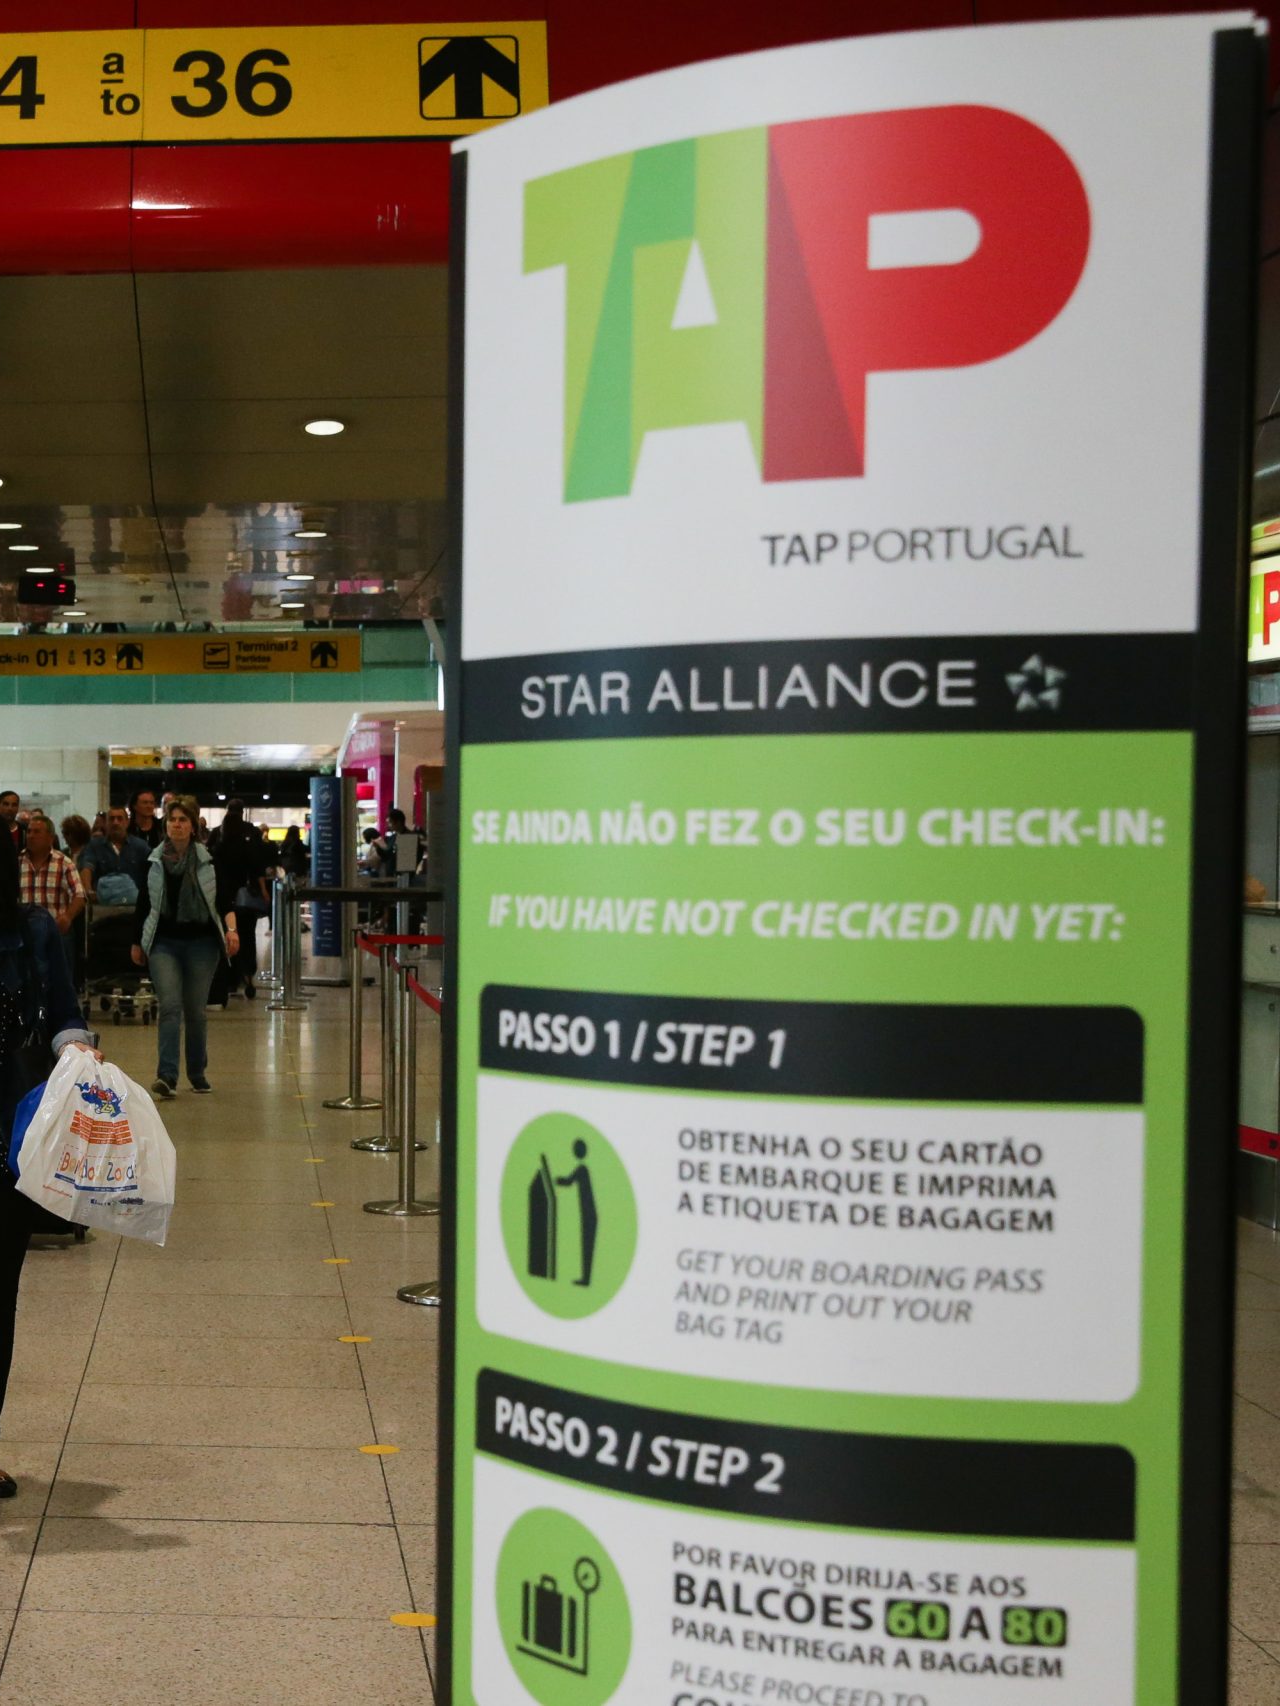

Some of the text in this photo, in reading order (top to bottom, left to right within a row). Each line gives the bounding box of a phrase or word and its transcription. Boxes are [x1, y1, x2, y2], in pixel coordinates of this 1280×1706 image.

[101, 52, 125, 75] a
[171, 48, 293, 117] 36
[101, 87, 141, 115] to
[523, 103, 1092, 505] TAP
[761, 524, 1084, 567] TAP PORTUGAL
[36, 648, 59, 668] 01
[82, 647, 106, 667] 13
[236, 640, 299, 653] Terminal 2
[521, 660, 976, 719] STAR ALLIANCE
[471, 802, 1167, 847] SE AINDA NÃO FEZ O SEU CHECK-IN:
[488, 894, 1126, 941] IF YOU HAVE NOT CHECKED IN YET:
[498, 1009, 787, 1069] PASSO 1 / STEP 1
[678, 1128, 1042, 1166] OBTENHA O SEU CARTÃO
[678, 1161, 1056, 1199] DE EMBARQUE E IMPRIMA
[677, 1193, 1055, 1233] A ETIQUETA DE BAGAGEM
[677, 1249, 1045, 1294] GET YOUR BOARDING PASS
[675, 1281, 973, 1324] AND PRINT OUT YOUR
[675, 1311, 784, 1345] BAG TAG
[495, 1396, 786, 1494] PASSO 2 / STEP 2
[672, 1541, 1027, 1599] POR FAVOR DIRIJA-SE AOS
[672, 1571, 1066, 1645] BALCÕES 60 A 80
[671, 1616, 1064, 1679] PARA ENTREGAR A BAGAGEM
[670, 1659, 756, 1696] PLEASE
[761, 1679, 884, 1706] PROCEED
